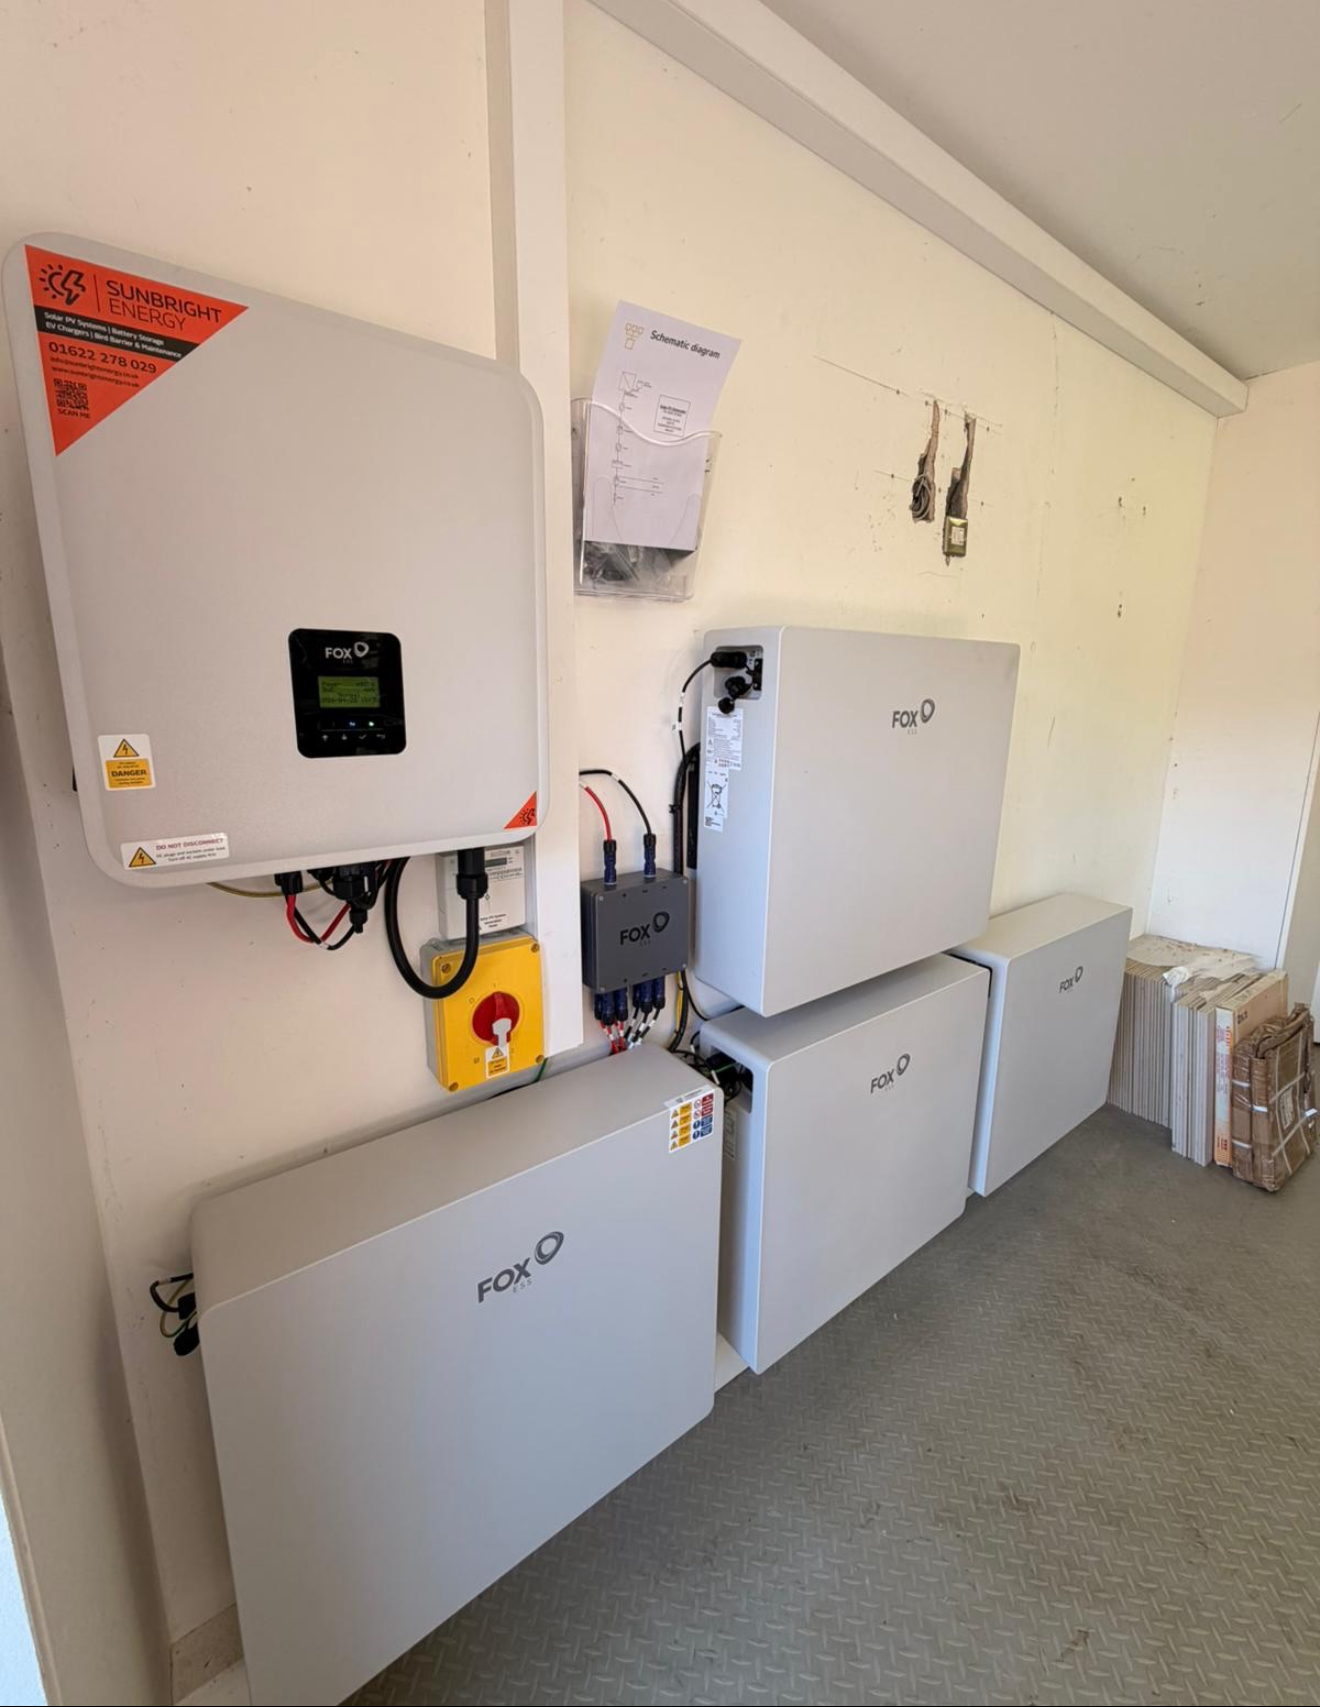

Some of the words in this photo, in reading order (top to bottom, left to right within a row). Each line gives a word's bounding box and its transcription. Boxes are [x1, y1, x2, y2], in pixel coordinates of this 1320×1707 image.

[106, 280, 222, 324] SUNBRIGHT
[109, 297, 186, 331] ENERGY
[44, 311, 64, 322] Solar
[65, 314, 76, 325] PV
[77, 319, 107, 332] Systems
[111, 327, 137, 340] Battery
[45, 322, 56, 330] EV
[57, 323, 90, 338] Chargers
[94, 332, 109, 342] Bird
[141, 343, 182, 358] Maintenance
[650, 330, 690, 350] Schematic
[690, 343, 721, 359] diagram
[48, 342, 96, 361] 01622
[100, 352, 128, 368] 278
[130, 360, 157, 374] 029
[58, 408, 78, 417] SCAN
[325, 647, 352, 659] FOX
[892, 710, 918, 729] FOX
[111, 769, 147, 777] DANGER
[183, 838, 223, 848] DISCONNECT
[620, 924, 651, 946] FOX
[870, 1068, 894, 1094] FOX
[478, 1257, 532, 1304] FOX
